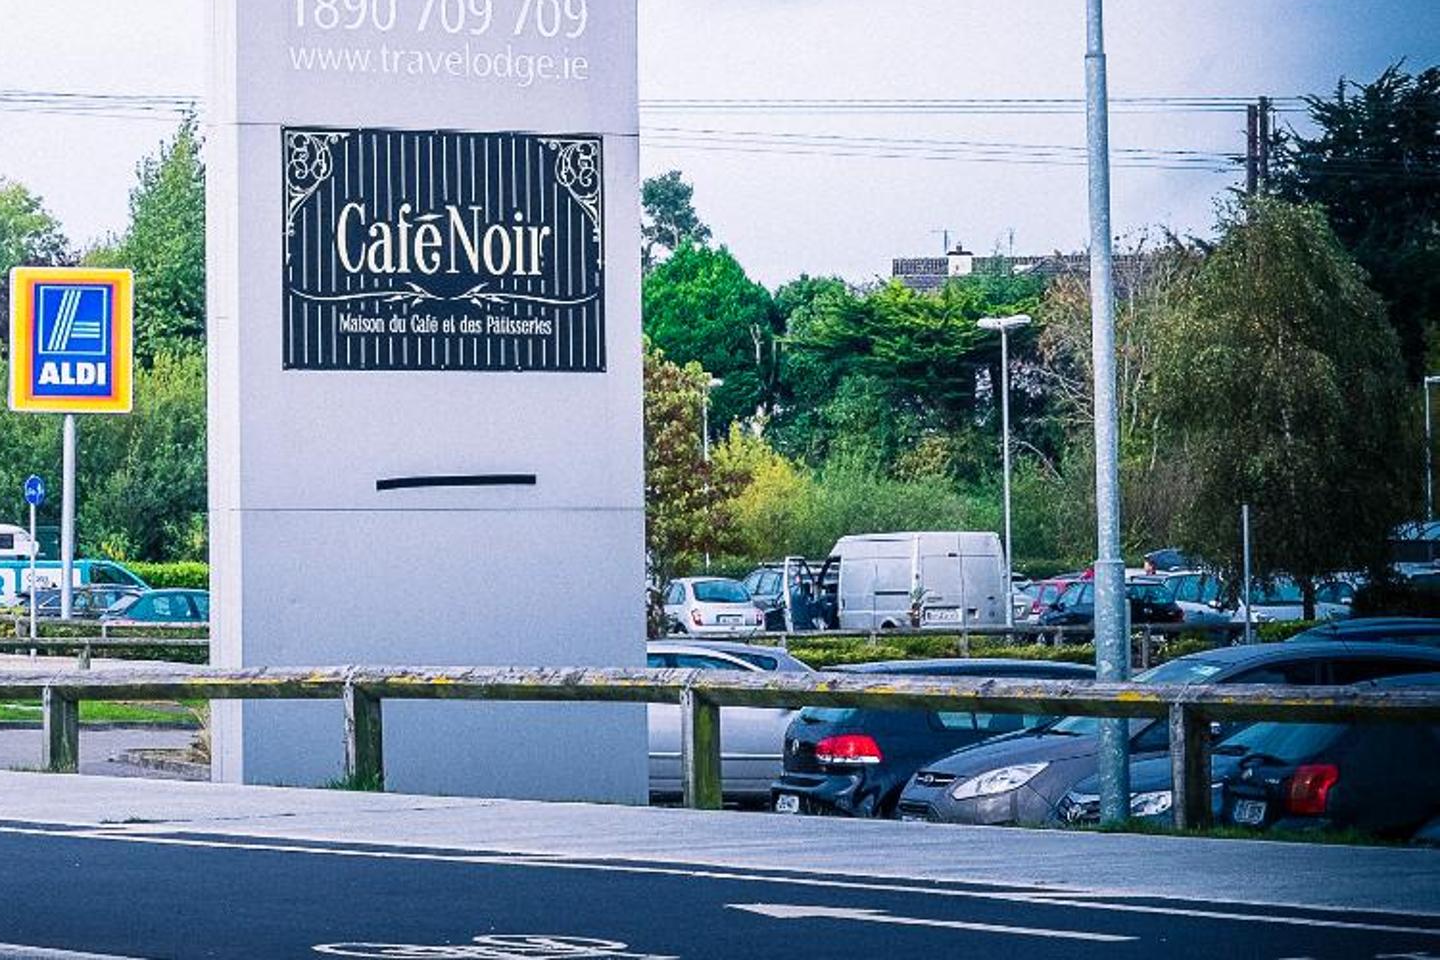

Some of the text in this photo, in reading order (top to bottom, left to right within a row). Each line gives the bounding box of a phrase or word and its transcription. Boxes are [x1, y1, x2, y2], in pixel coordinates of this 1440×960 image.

[288, 42, 589, 88] www.travelodge.ie
[339, 313, 385, 333] Maison
[389, 314, 406, 333] du
[410, 314, 439, 334] Café
[442, 314, 456, 333] et
[460, 314, 482, 334] des
[38, 360, 107, 386] ALDI
